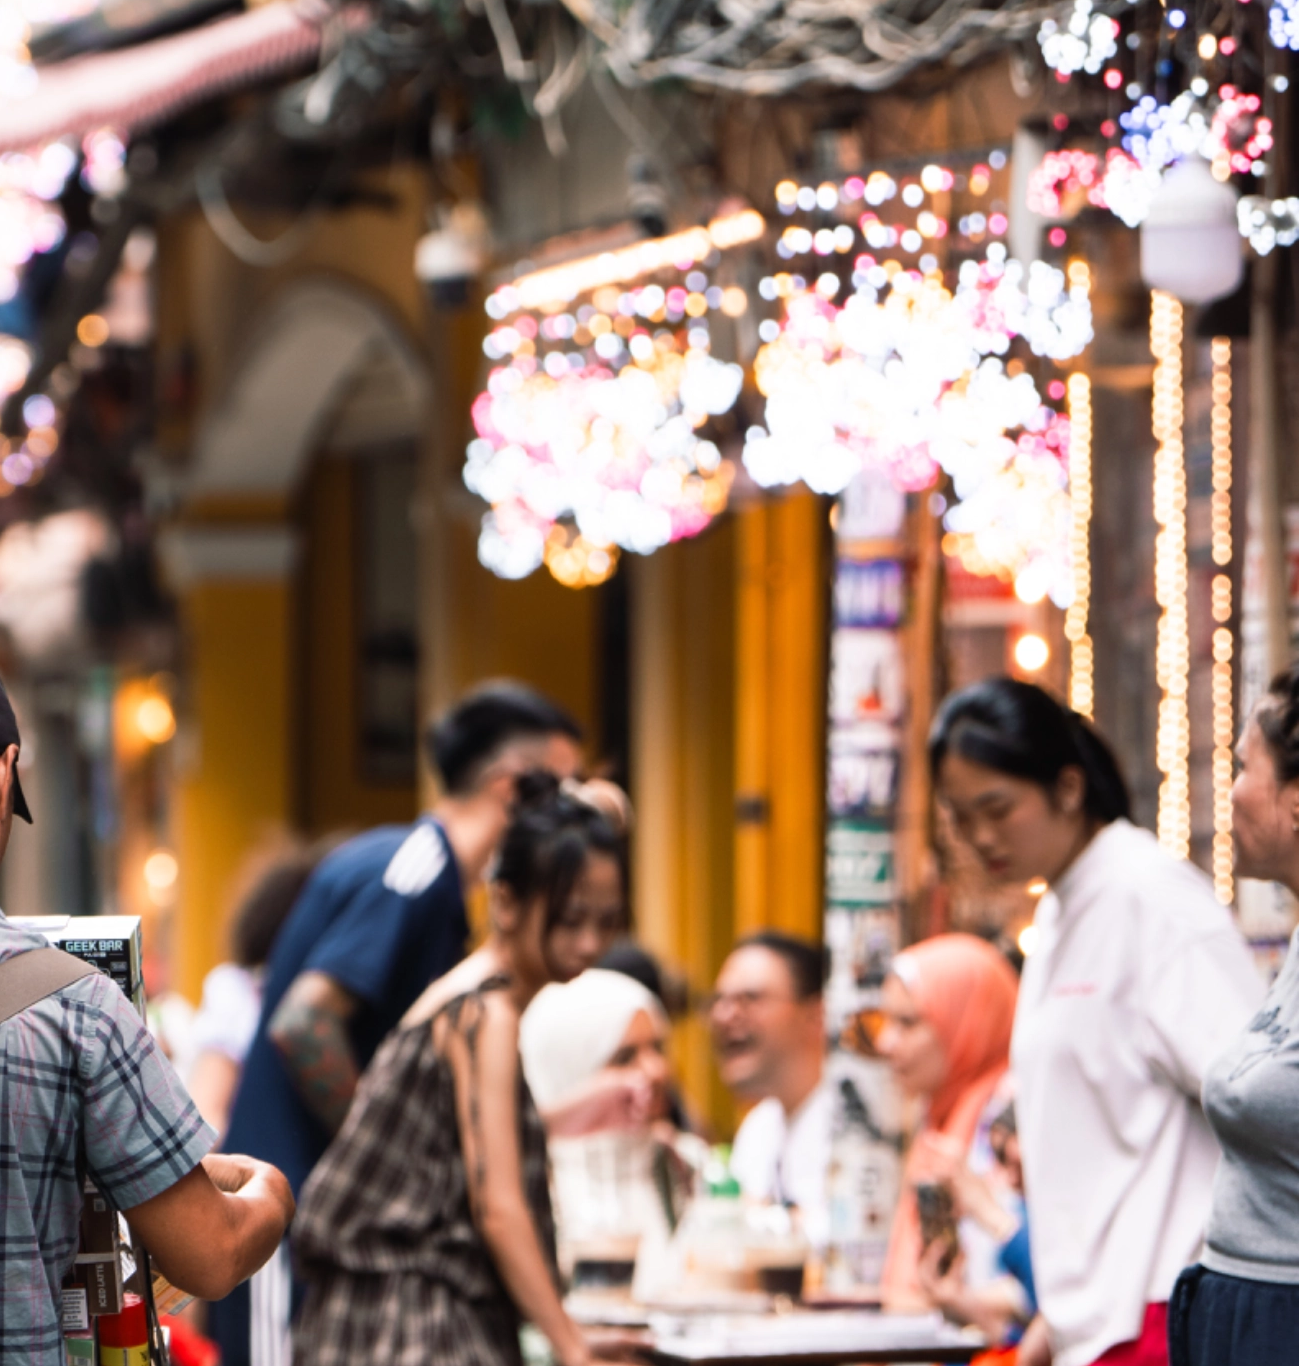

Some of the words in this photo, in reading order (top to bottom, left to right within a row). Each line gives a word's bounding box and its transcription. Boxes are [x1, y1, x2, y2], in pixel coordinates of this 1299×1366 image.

[65, 941, 97, 952] GEEK
[98, 940, 123, 951] BAR
[95, 1263, 106, 1287] LATTE
[97, 1288, 107, 1308] ICED
